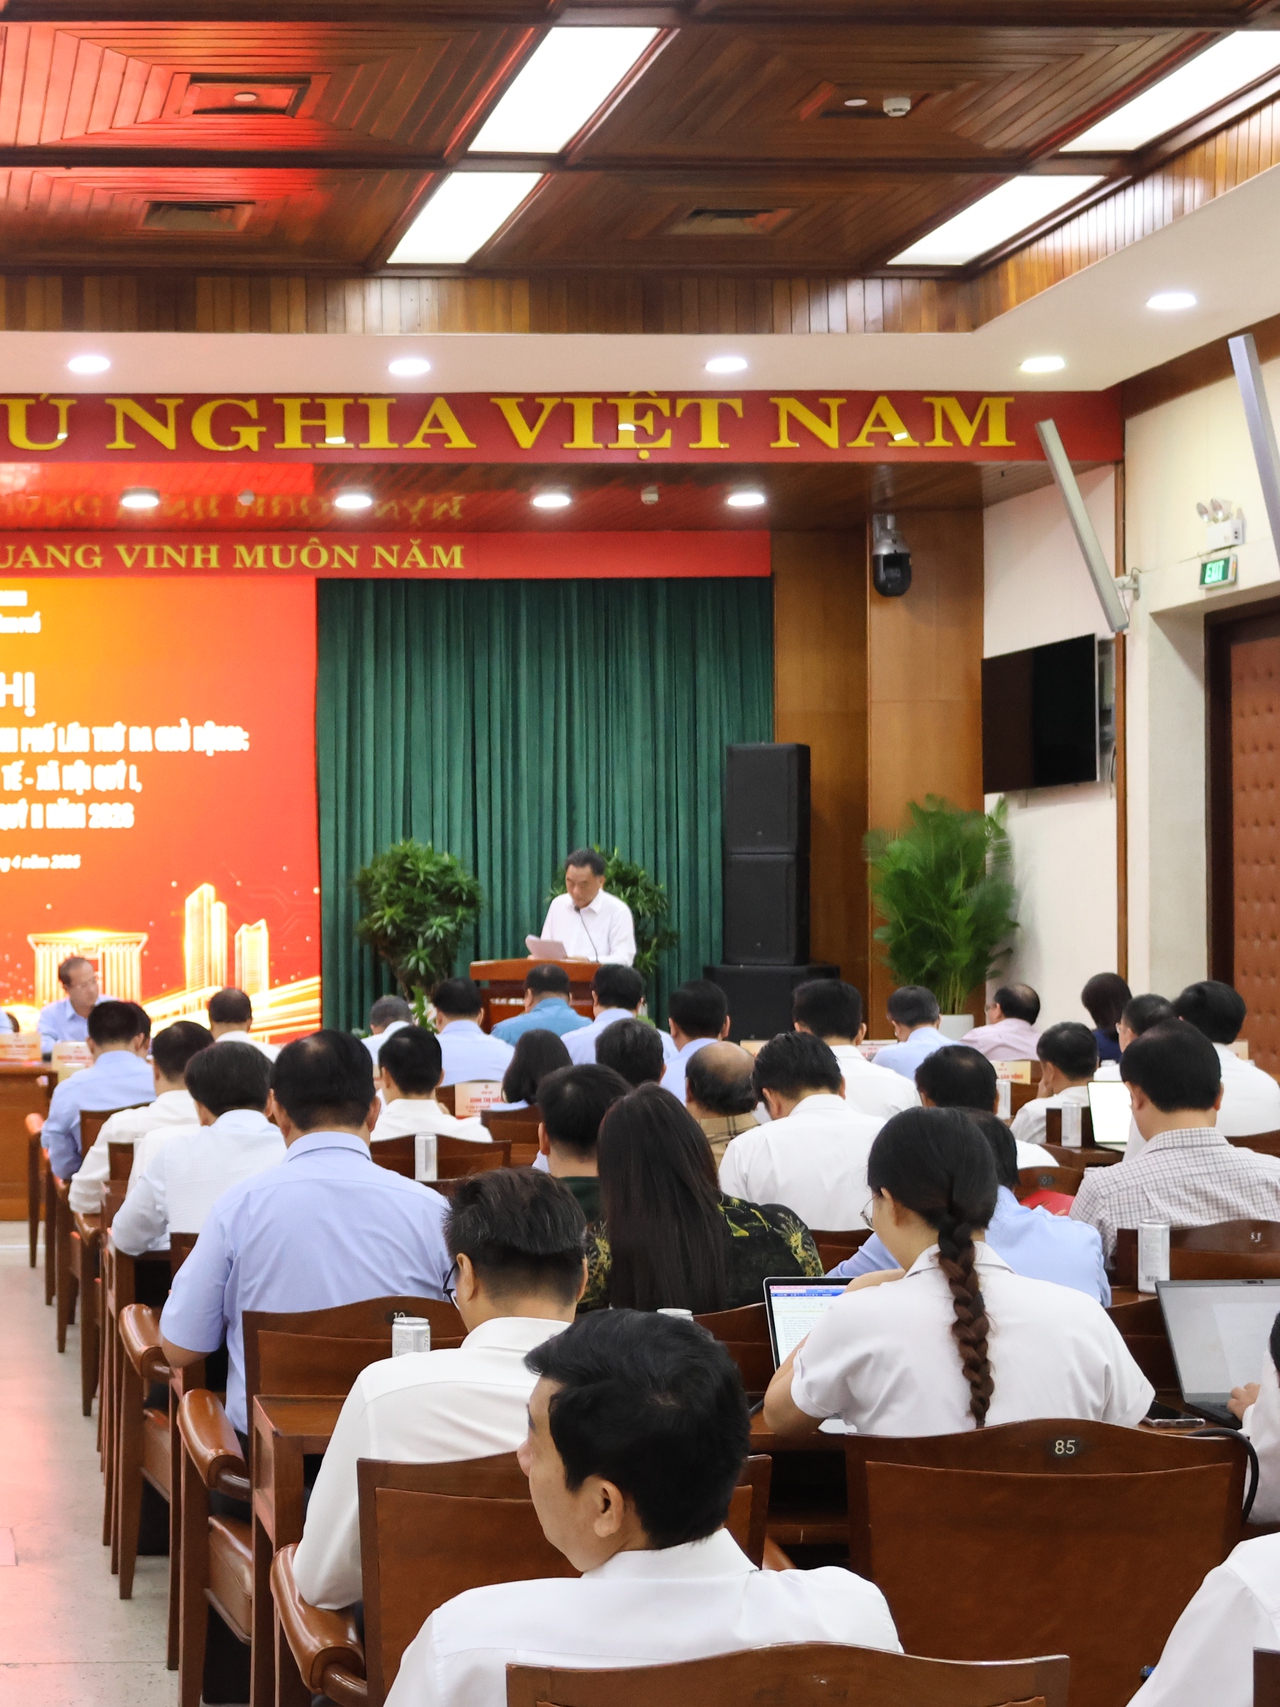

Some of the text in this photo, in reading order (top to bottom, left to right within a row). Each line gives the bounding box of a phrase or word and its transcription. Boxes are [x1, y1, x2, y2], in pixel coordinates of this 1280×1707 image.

[491, 390, 743, 460] VIỆT
[770, 395, 1017, 450] NAM
[115, 545, 221, 569] VINH
[233, 538, 359, 569] MUÔN
[372, 539, 465, 569] NĂM
[1054, 1439, 1076, 1455] 85
